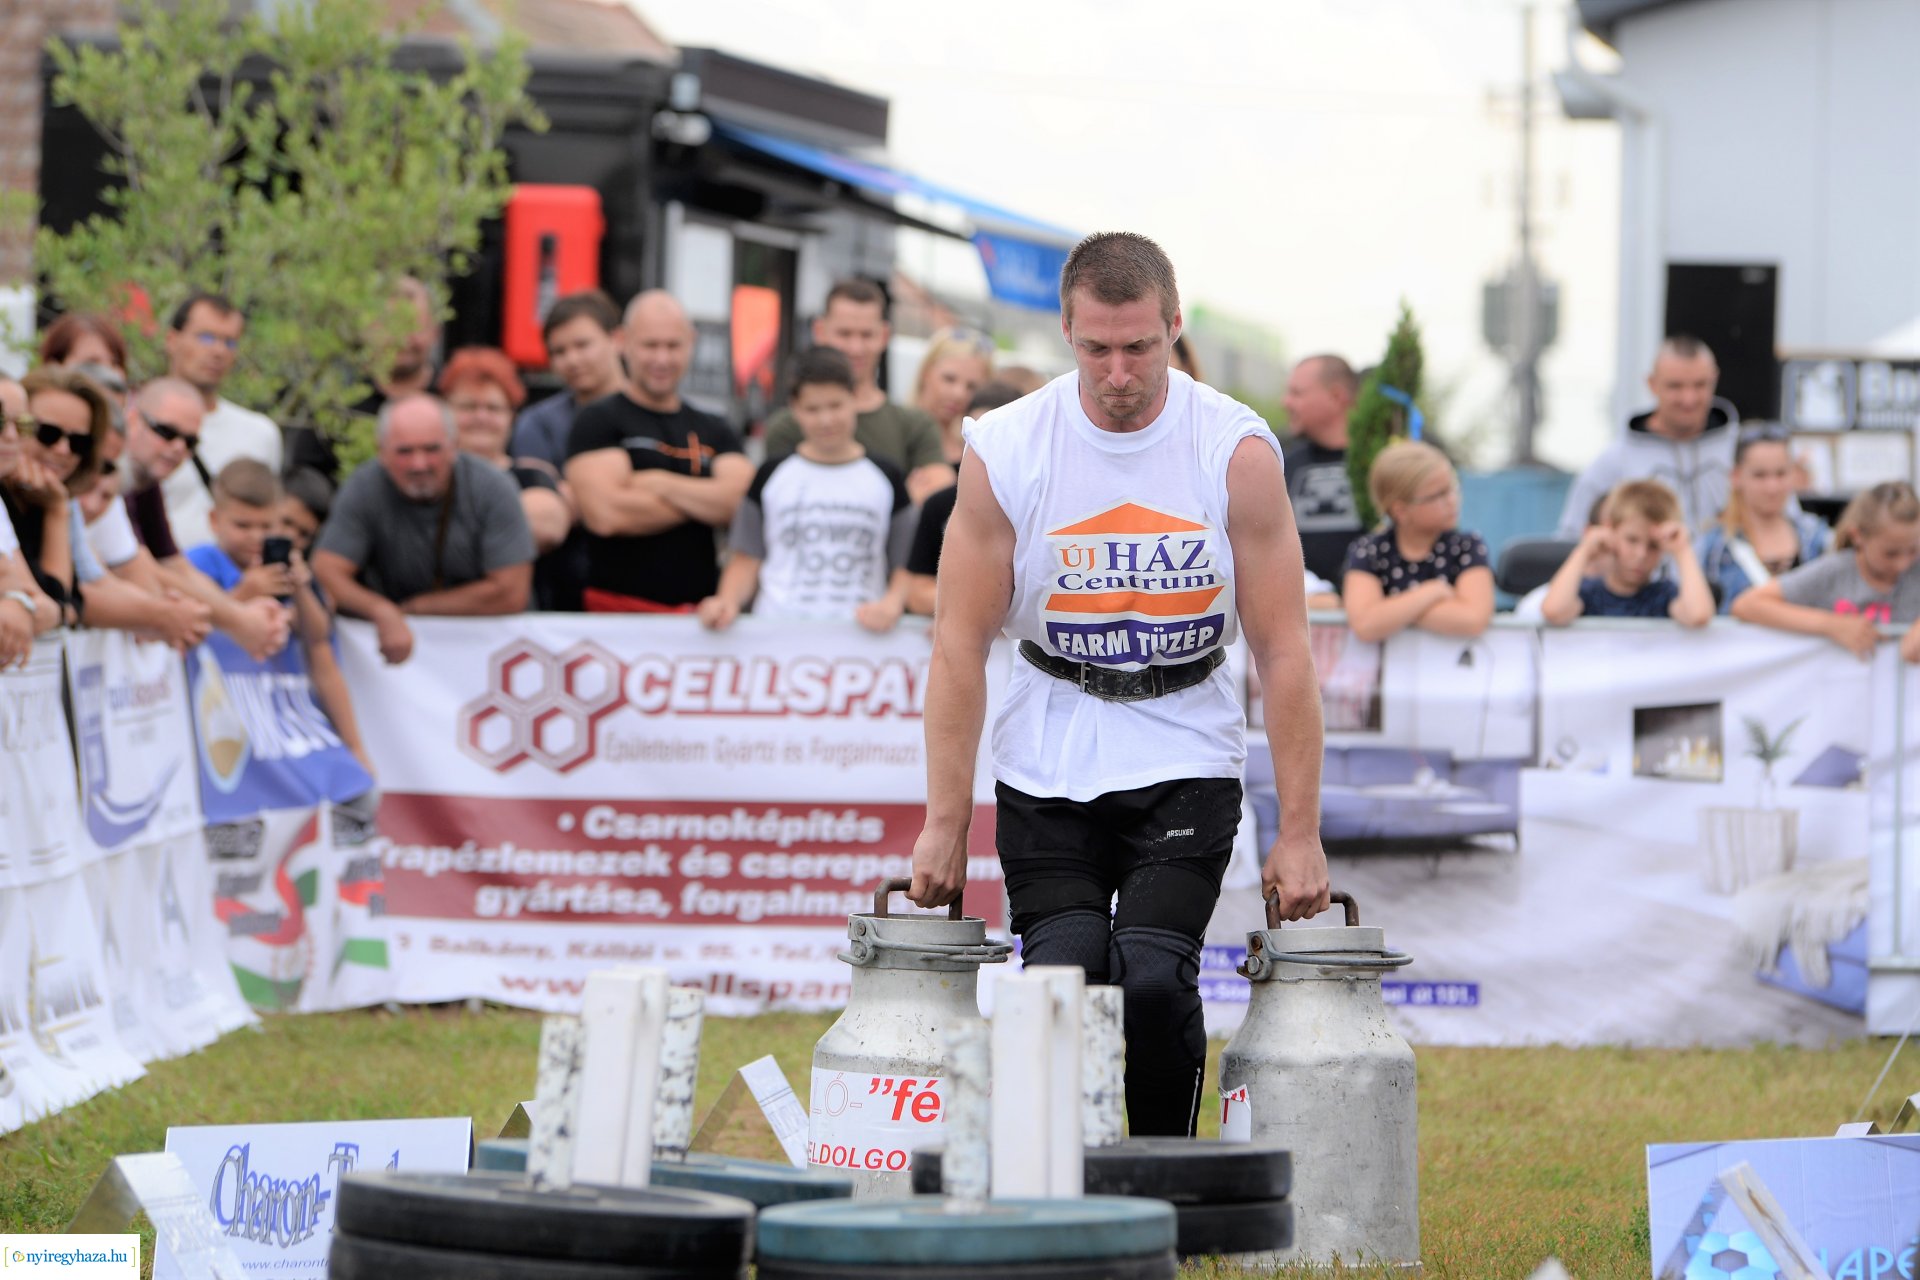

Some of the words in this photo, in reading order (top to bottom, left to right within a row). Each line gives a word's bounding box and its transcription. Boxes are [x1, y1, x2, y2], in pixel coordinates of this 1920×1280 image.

[1059, 544, 1097, 571] ÚJ
[1104, 535, 1210, 572] HÁZ
[1057, 572, 1216, 591] Centrum
[1057, 629, 1131, 657] FARM
[582, 805, 885, 847] Csarnoképítés
[678, 845, 732, 877] és
[474, 881, 672, 918] gyártása,
